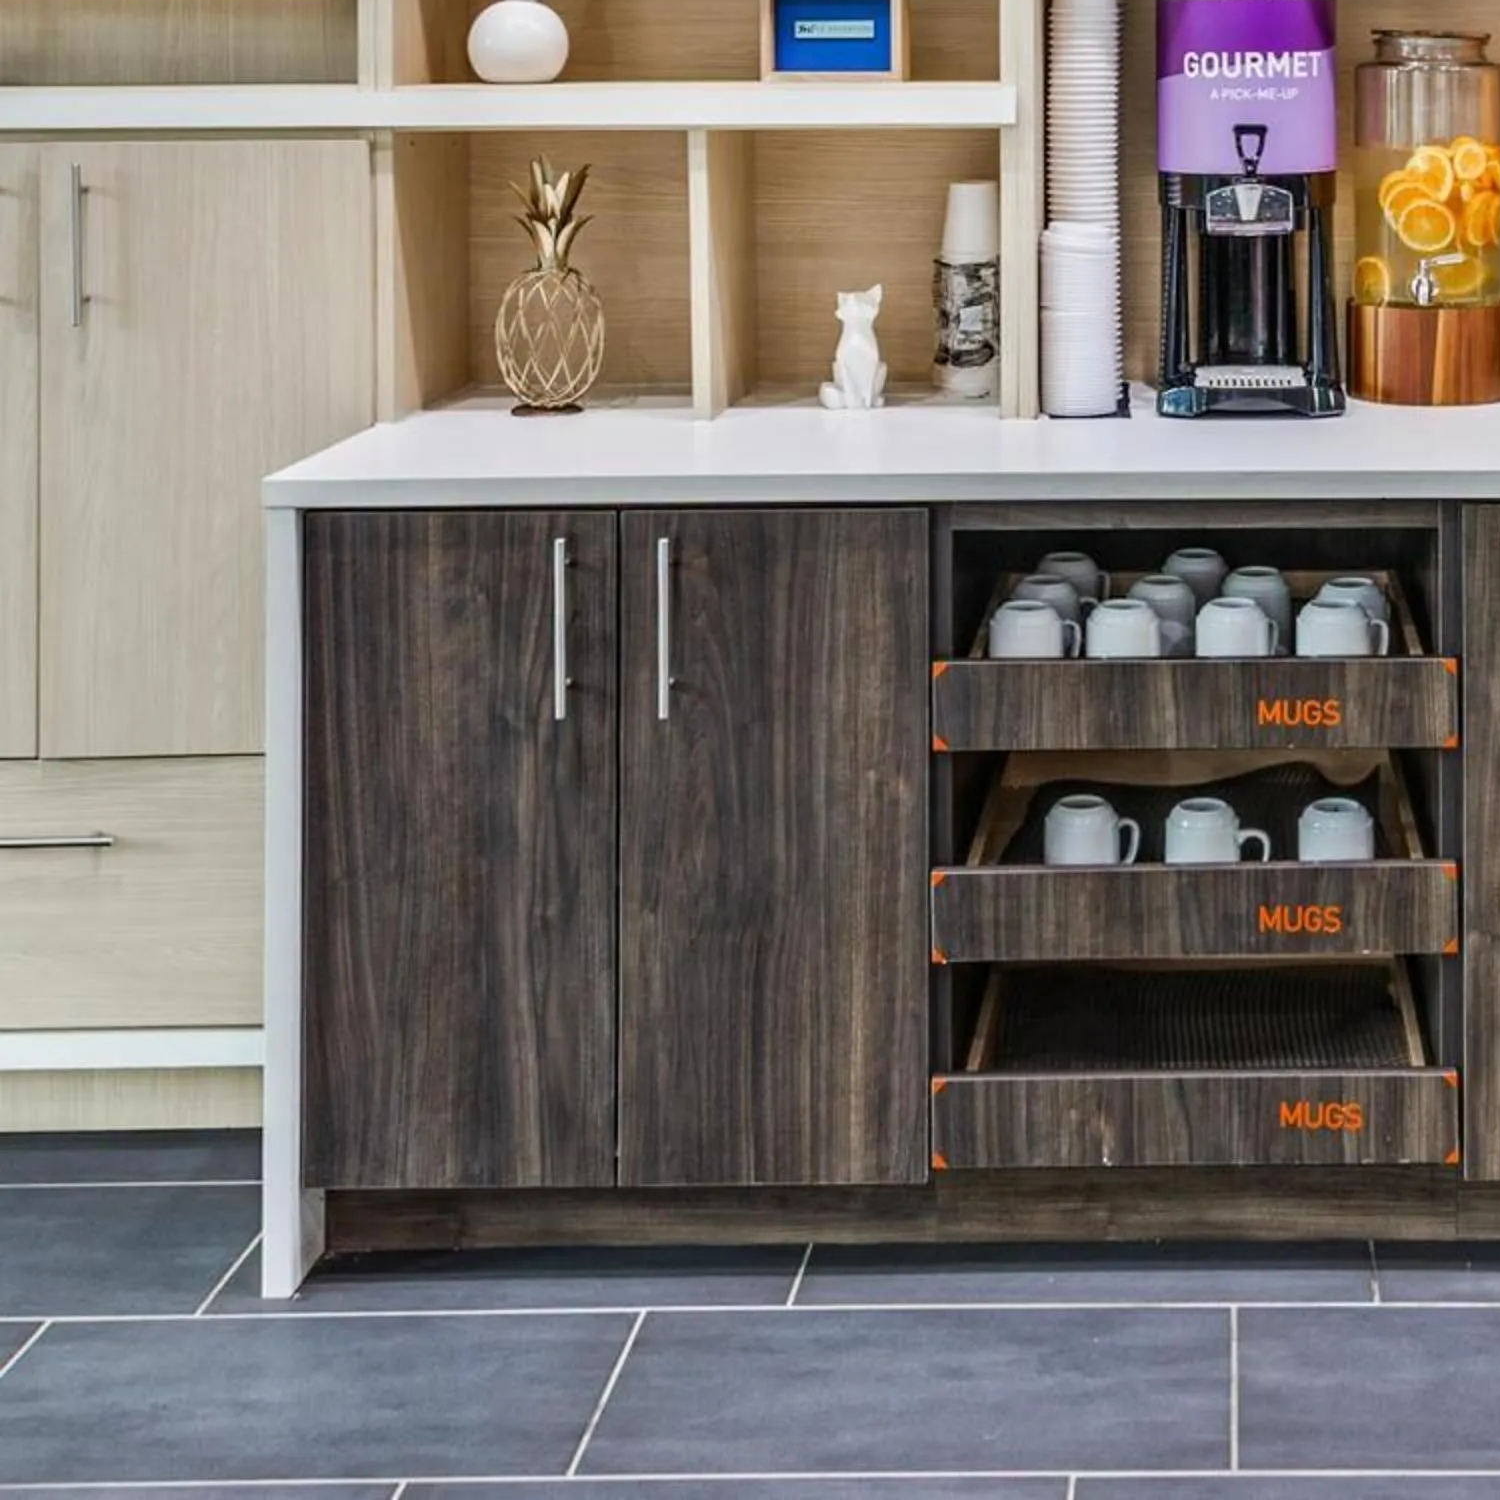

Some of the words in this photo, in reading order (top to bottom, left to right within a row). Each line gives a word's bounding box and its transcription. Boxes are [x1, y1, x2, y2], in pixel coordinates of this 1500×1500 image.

[1183, 51, 1322, 79] GOURMET
[1210, 87, 1220, 101] A
[1221, 87, 1299, 101] PICK-ME-UP
[1257, 699, 1342, 727] MUGS
[1258, 904, 1342, 933] MUGS
[1279, 1101, 1363, 1131] MUGS
